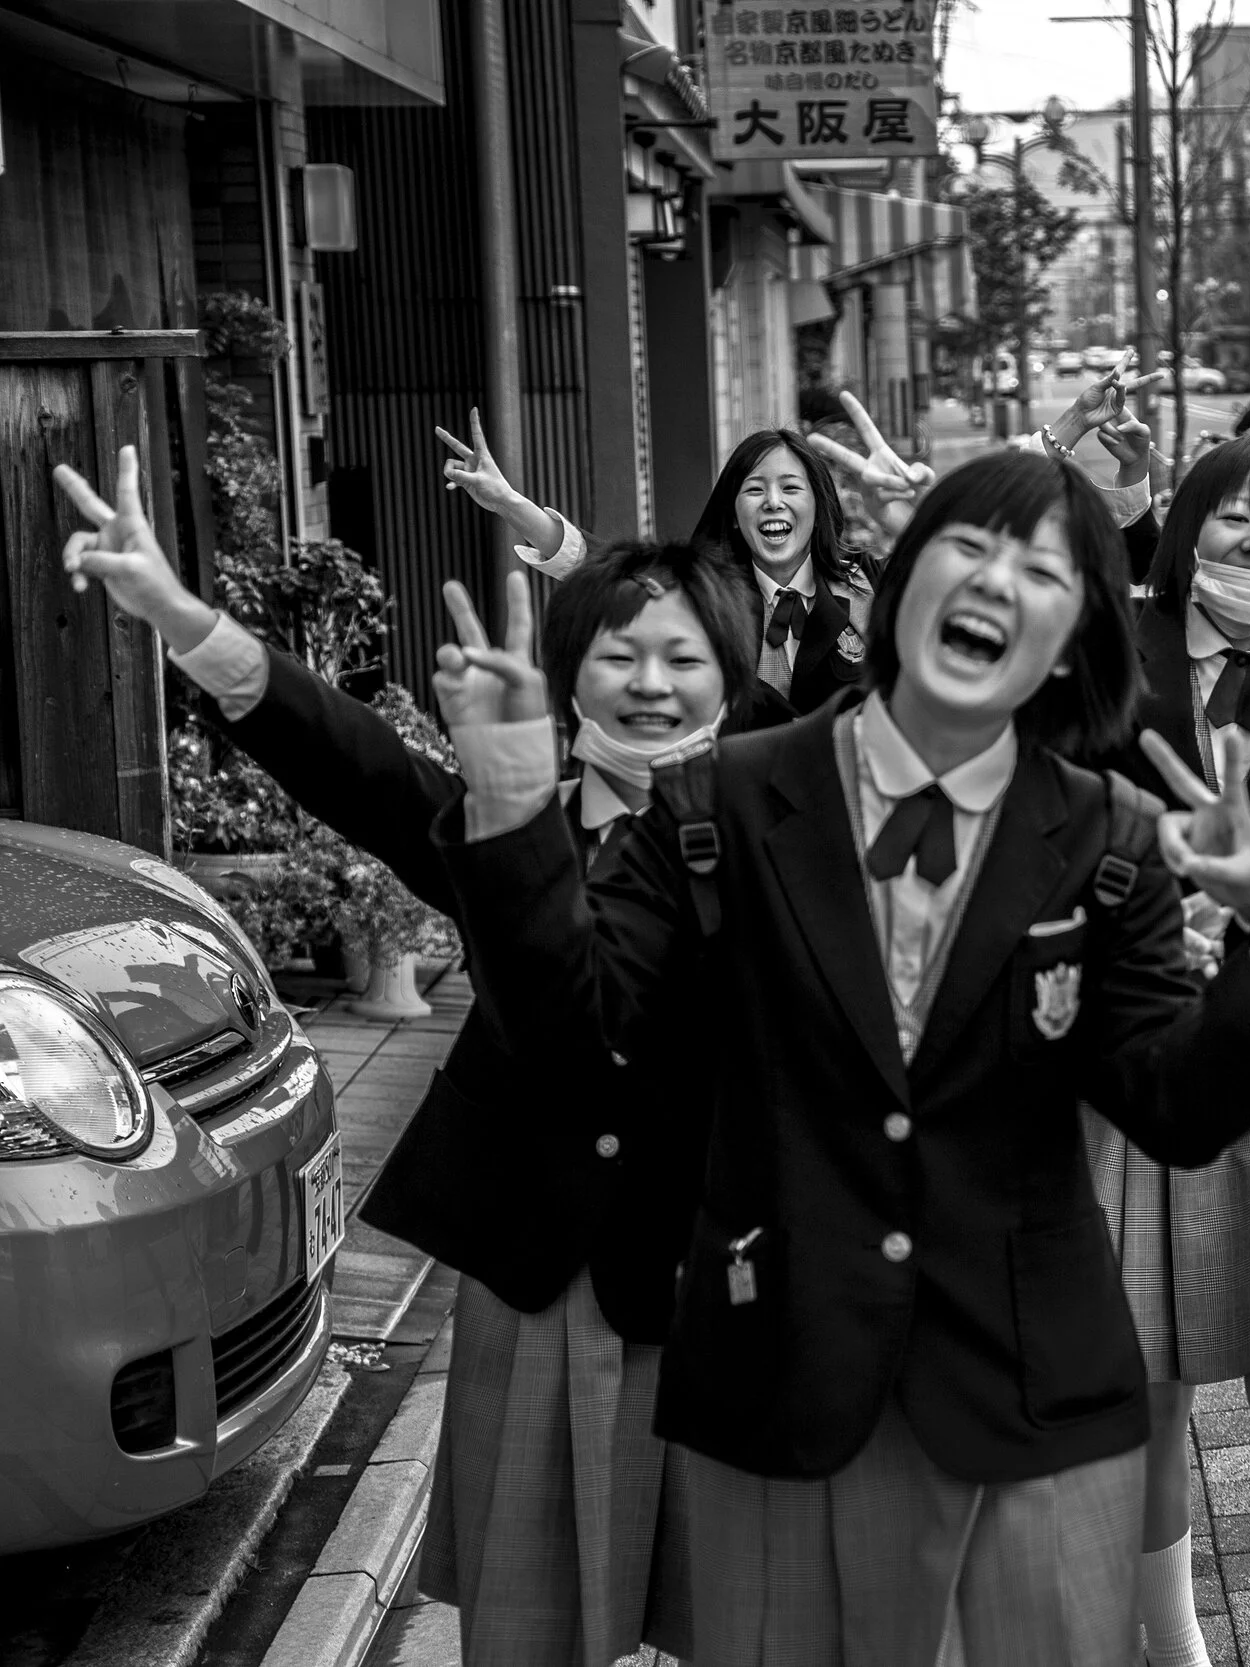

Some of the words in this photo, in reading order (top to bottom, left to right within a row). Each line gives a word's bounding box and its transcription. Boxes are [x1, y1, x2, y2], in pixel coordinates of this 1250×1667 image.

[726, 39, 915, 65] 名物京都風たぬき
[764, 72, 879, 91] 味自慢のだし
[733, 98, 915, 146] 大阪屋
[314, 1176, 341, 1265] 74-47
